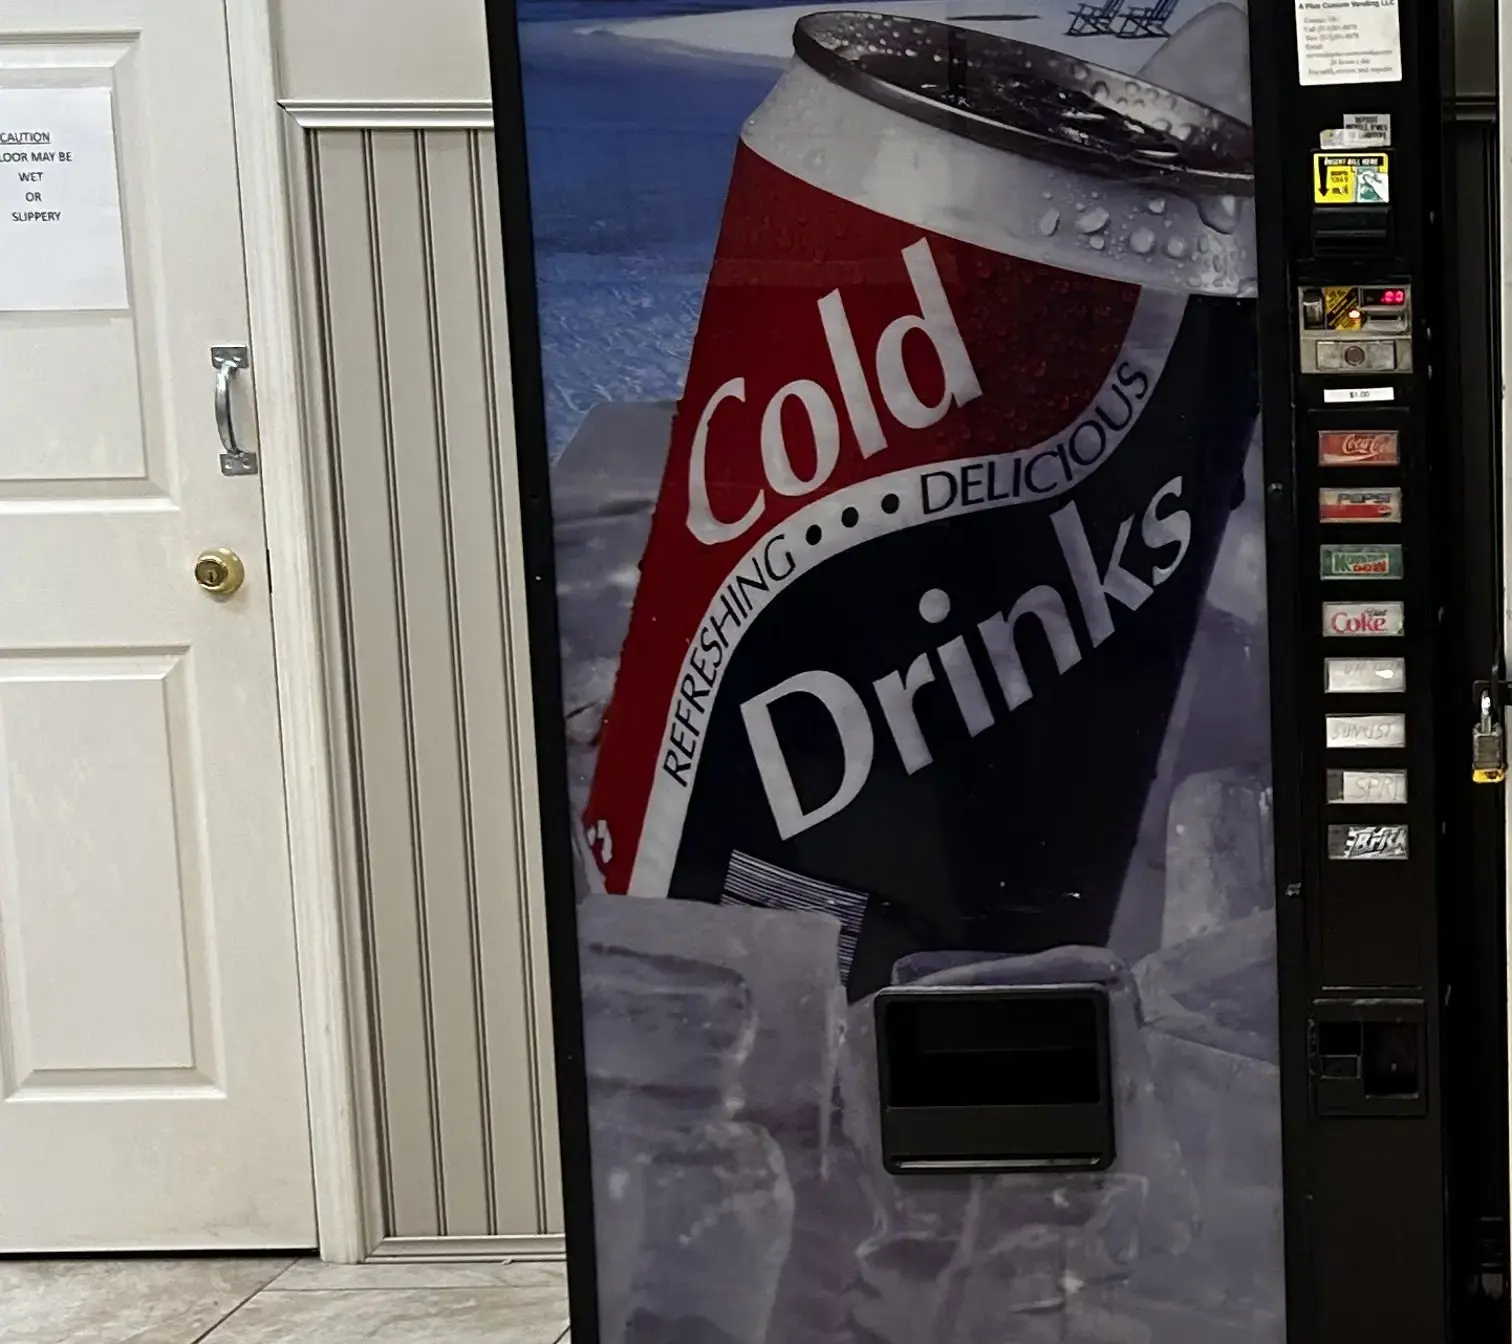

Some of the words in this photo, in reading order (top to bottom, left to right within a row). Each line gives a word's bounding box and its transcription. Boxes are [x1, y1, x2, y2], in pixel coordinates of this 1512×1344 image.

[0, 132, 50, 142] CAUTION
[0, 152, 29, 162] OOR
[32, 152, 55, 162] MAY
[59, 151, 72, 162] BE
[18, 172, 44, 182] WET
[26, 192, 42, 202] OR
[12, 212, 61, 222] SLIPPERY
[686, 237, 982, 545] Cold
[662, 534, 796, 788] REFRESHING
[921, 362, 1148, 514] DELICIOUS
[1332, 612, 1387, 634] Coke
[740, 476, 1192, 840] Drinks
